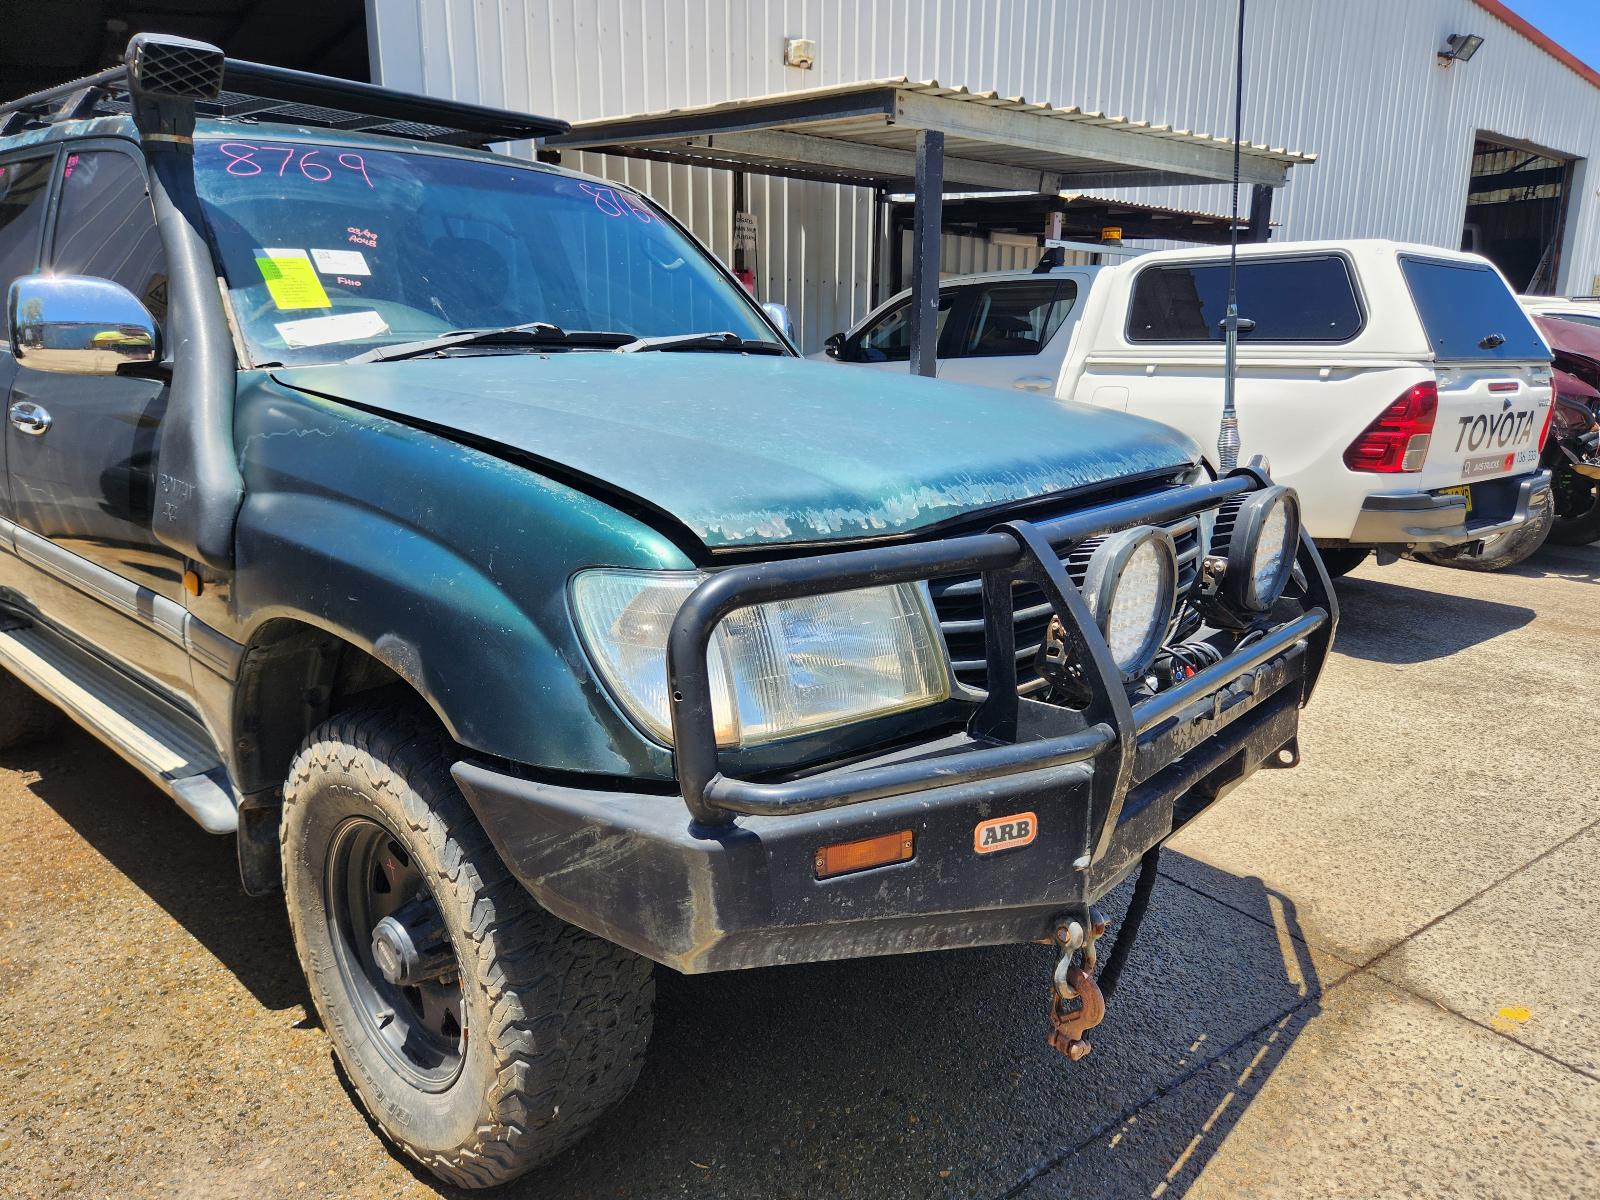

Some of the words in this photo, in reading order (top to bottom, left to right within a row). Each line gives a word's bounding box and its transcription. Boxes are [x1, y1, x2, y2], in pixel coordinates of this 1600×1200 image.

[220, 143, 374, 191] 8769
[1454, 410, 1535, 452] TOYOTA
[982, 820, 1031, 847] ARB
